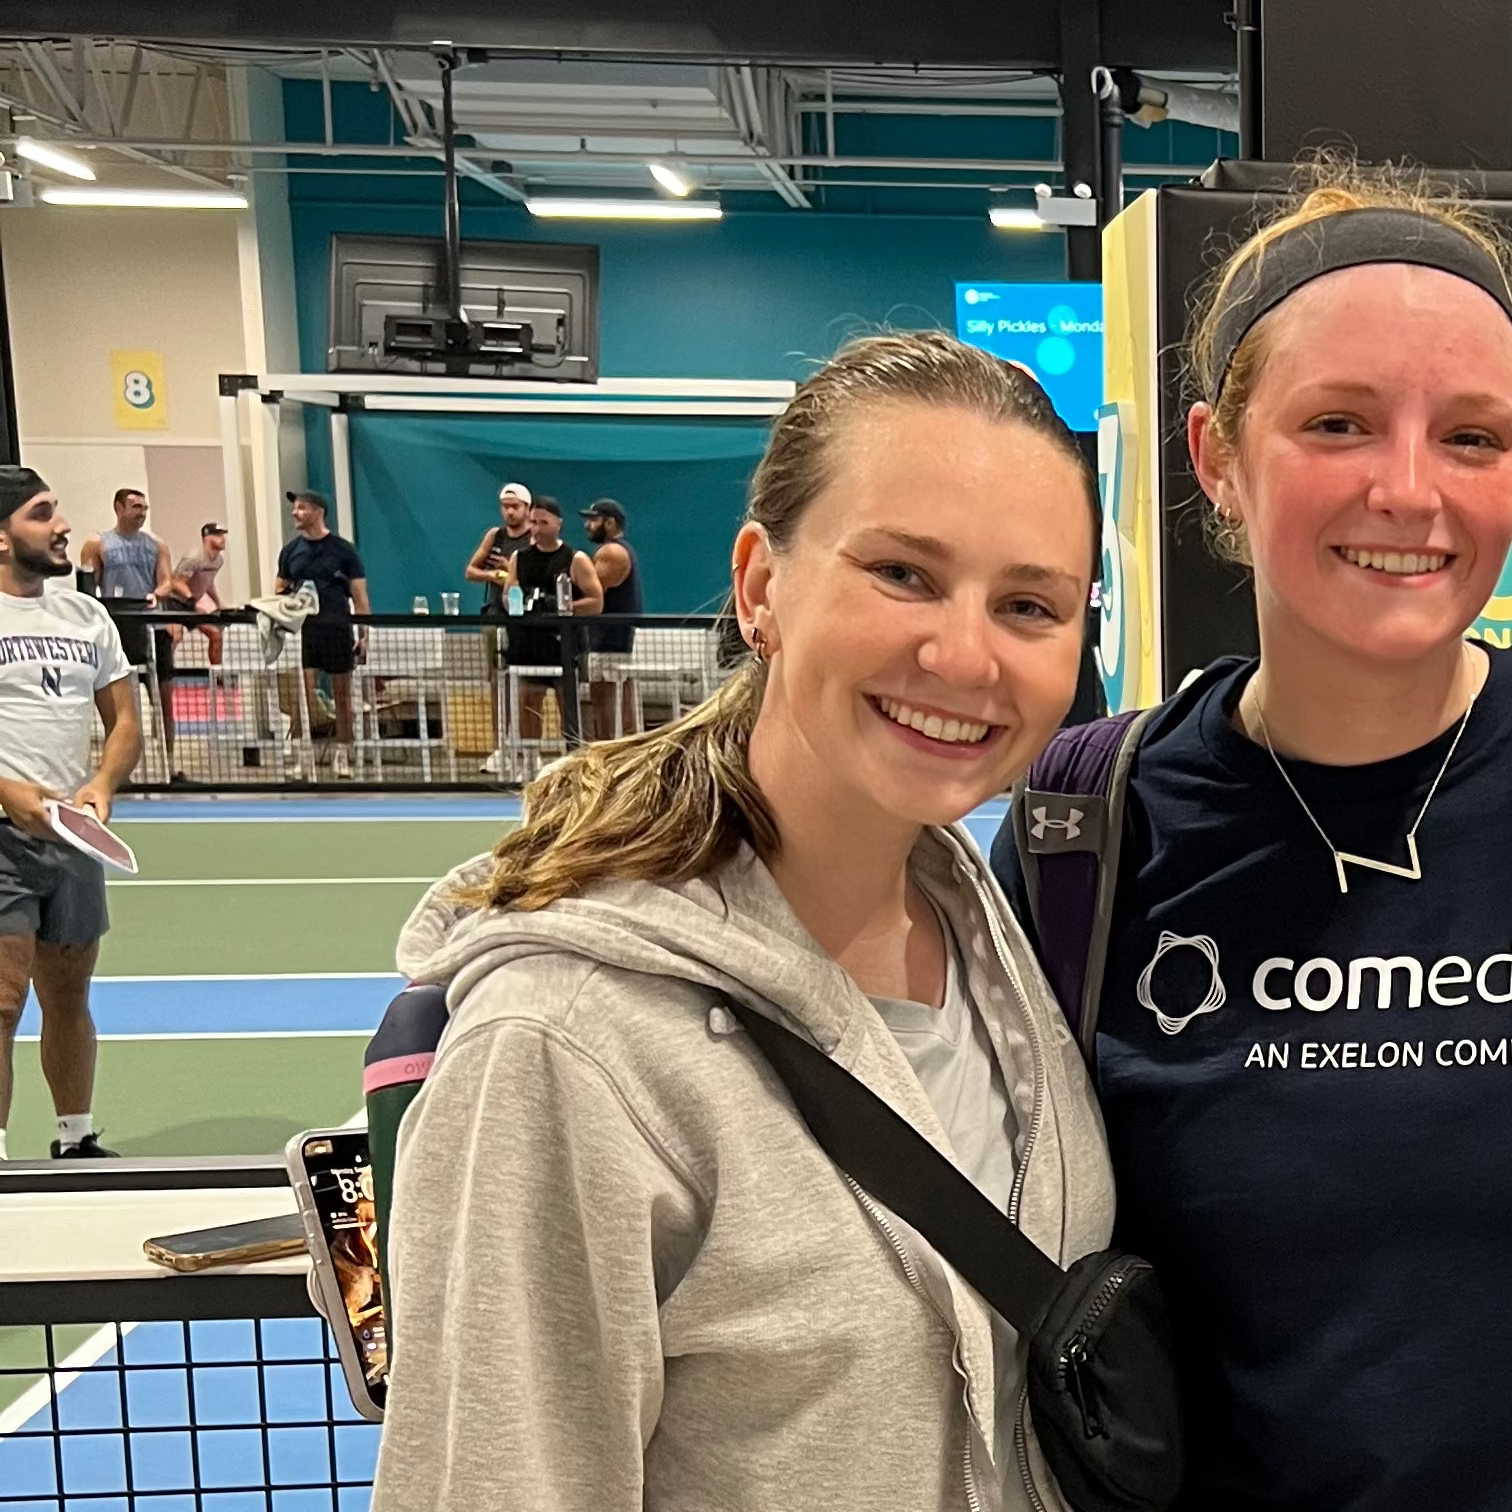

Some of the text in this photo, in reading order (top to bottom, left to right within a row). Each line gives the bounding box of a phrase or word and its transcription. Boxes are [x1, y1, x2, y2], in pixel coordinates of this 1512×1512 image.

[998, 319, 1047, 333] Pickles
[124, 370, 155, 409] 8
[1244, 1042, 1290, 1069] AN
[1300, 1040, 1424, 1069] EXELON
